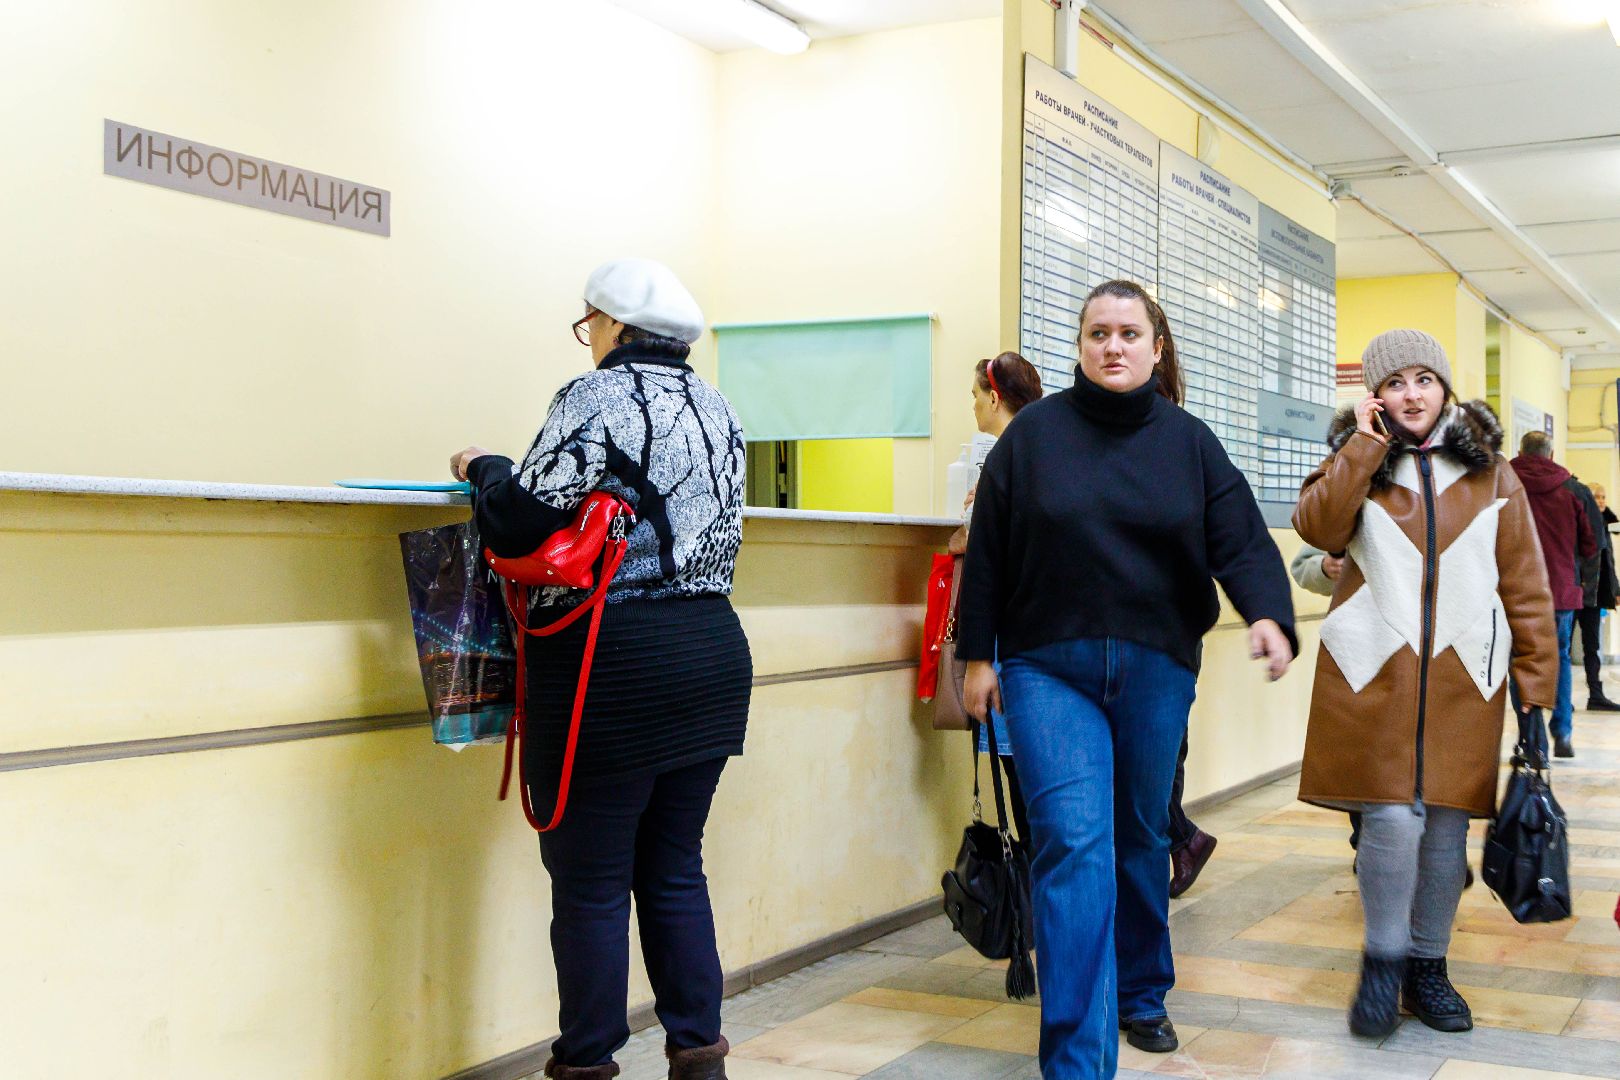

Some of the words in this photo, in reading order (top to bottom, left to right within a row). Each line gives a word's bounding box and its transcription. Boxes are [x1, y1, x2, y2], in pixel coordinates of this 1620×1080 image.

[1035, 90, 1062, 113] РАБОТЫ
[1063, 105, 1086, 127] ВРАЧЕЙ
[1090, 122, 1124, 149] УЧАСТКОВЫХ
[1124, 143, 1153, 168] ТЕРАПЕВТОВ
[1083, 100, 1118, 129] РАСПИСАНИЕ
[116, 127, 382, 223] ИНФОРМАЦИЯ
[1171, 172, 1195, 193] РАБОТЫ
[1195, 185, 1215, 204] ВРАЧЕЙ
[1217, 198, 1251, 225] СПЕЦИАЛИСТОВ
[1200, 170, 1231, 197] РАСПИСАНИЕ
